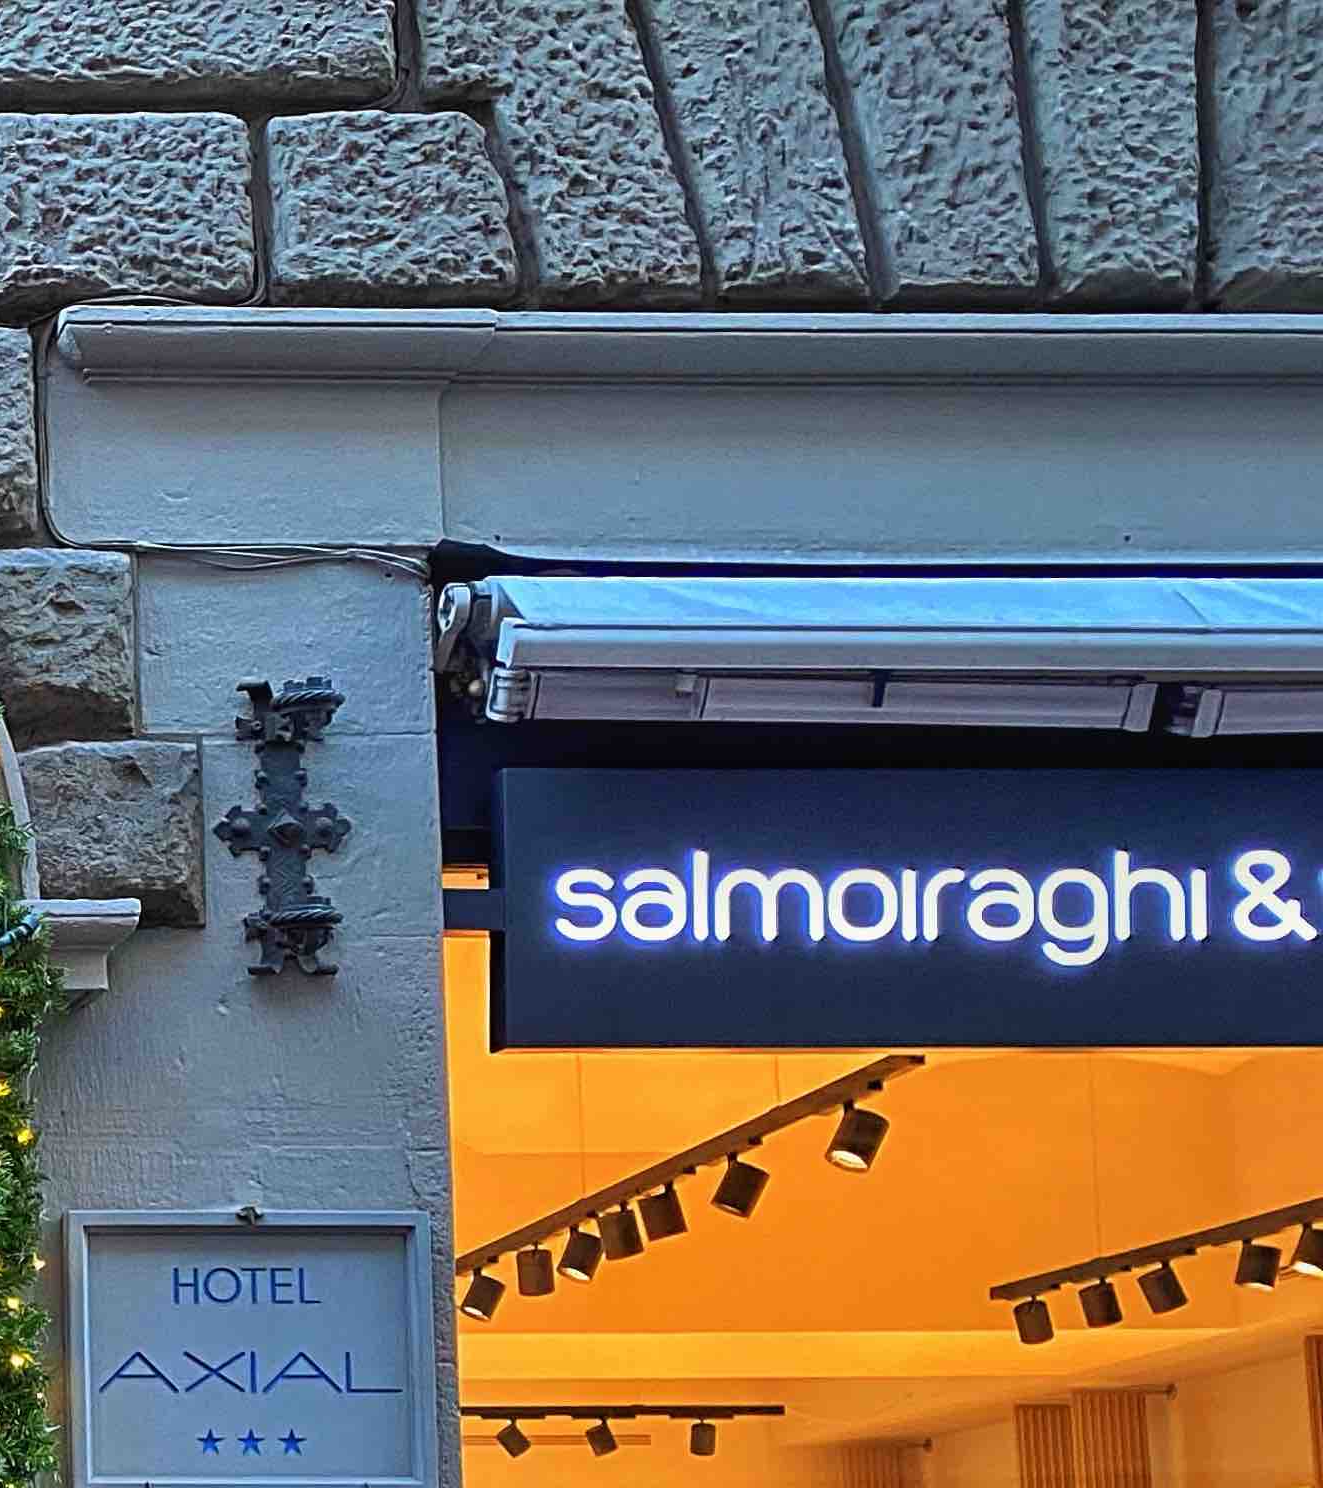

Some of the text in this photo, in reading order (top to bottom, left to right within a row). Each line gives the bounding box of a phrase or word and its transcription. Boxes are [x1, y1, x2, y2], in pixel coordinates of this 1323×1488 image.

[555, 848, 1320, 967] salmoiraghi &
[172, 1266, 323, 1305] HOTEL
[98, 1351, 403, 1393] AXIAL
